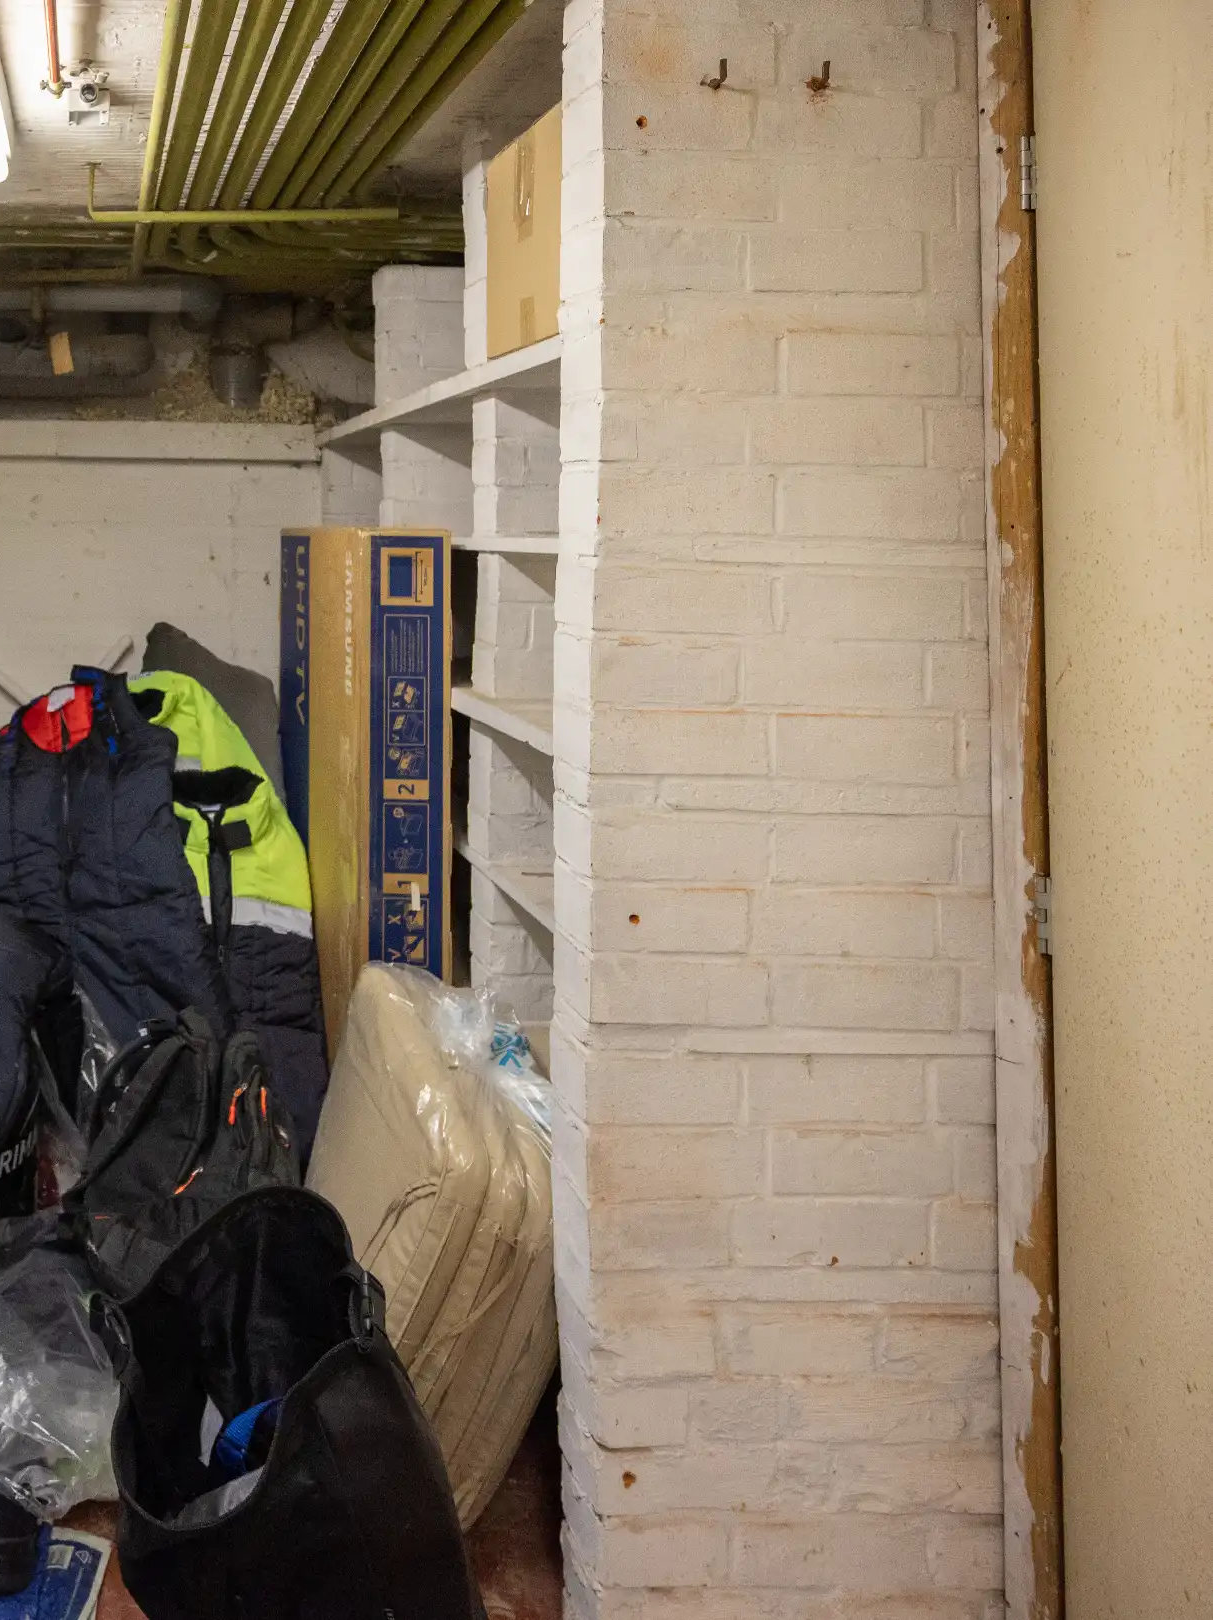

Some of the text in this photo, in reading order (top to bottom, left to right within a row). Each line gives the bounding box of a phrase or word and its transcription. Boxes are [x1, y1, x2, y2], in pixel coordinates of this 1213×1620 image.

[344, 551, 353, 696] SAMSUNG
[295, 660, 306, 726] TV
[397, 783, 415, 796] 2
